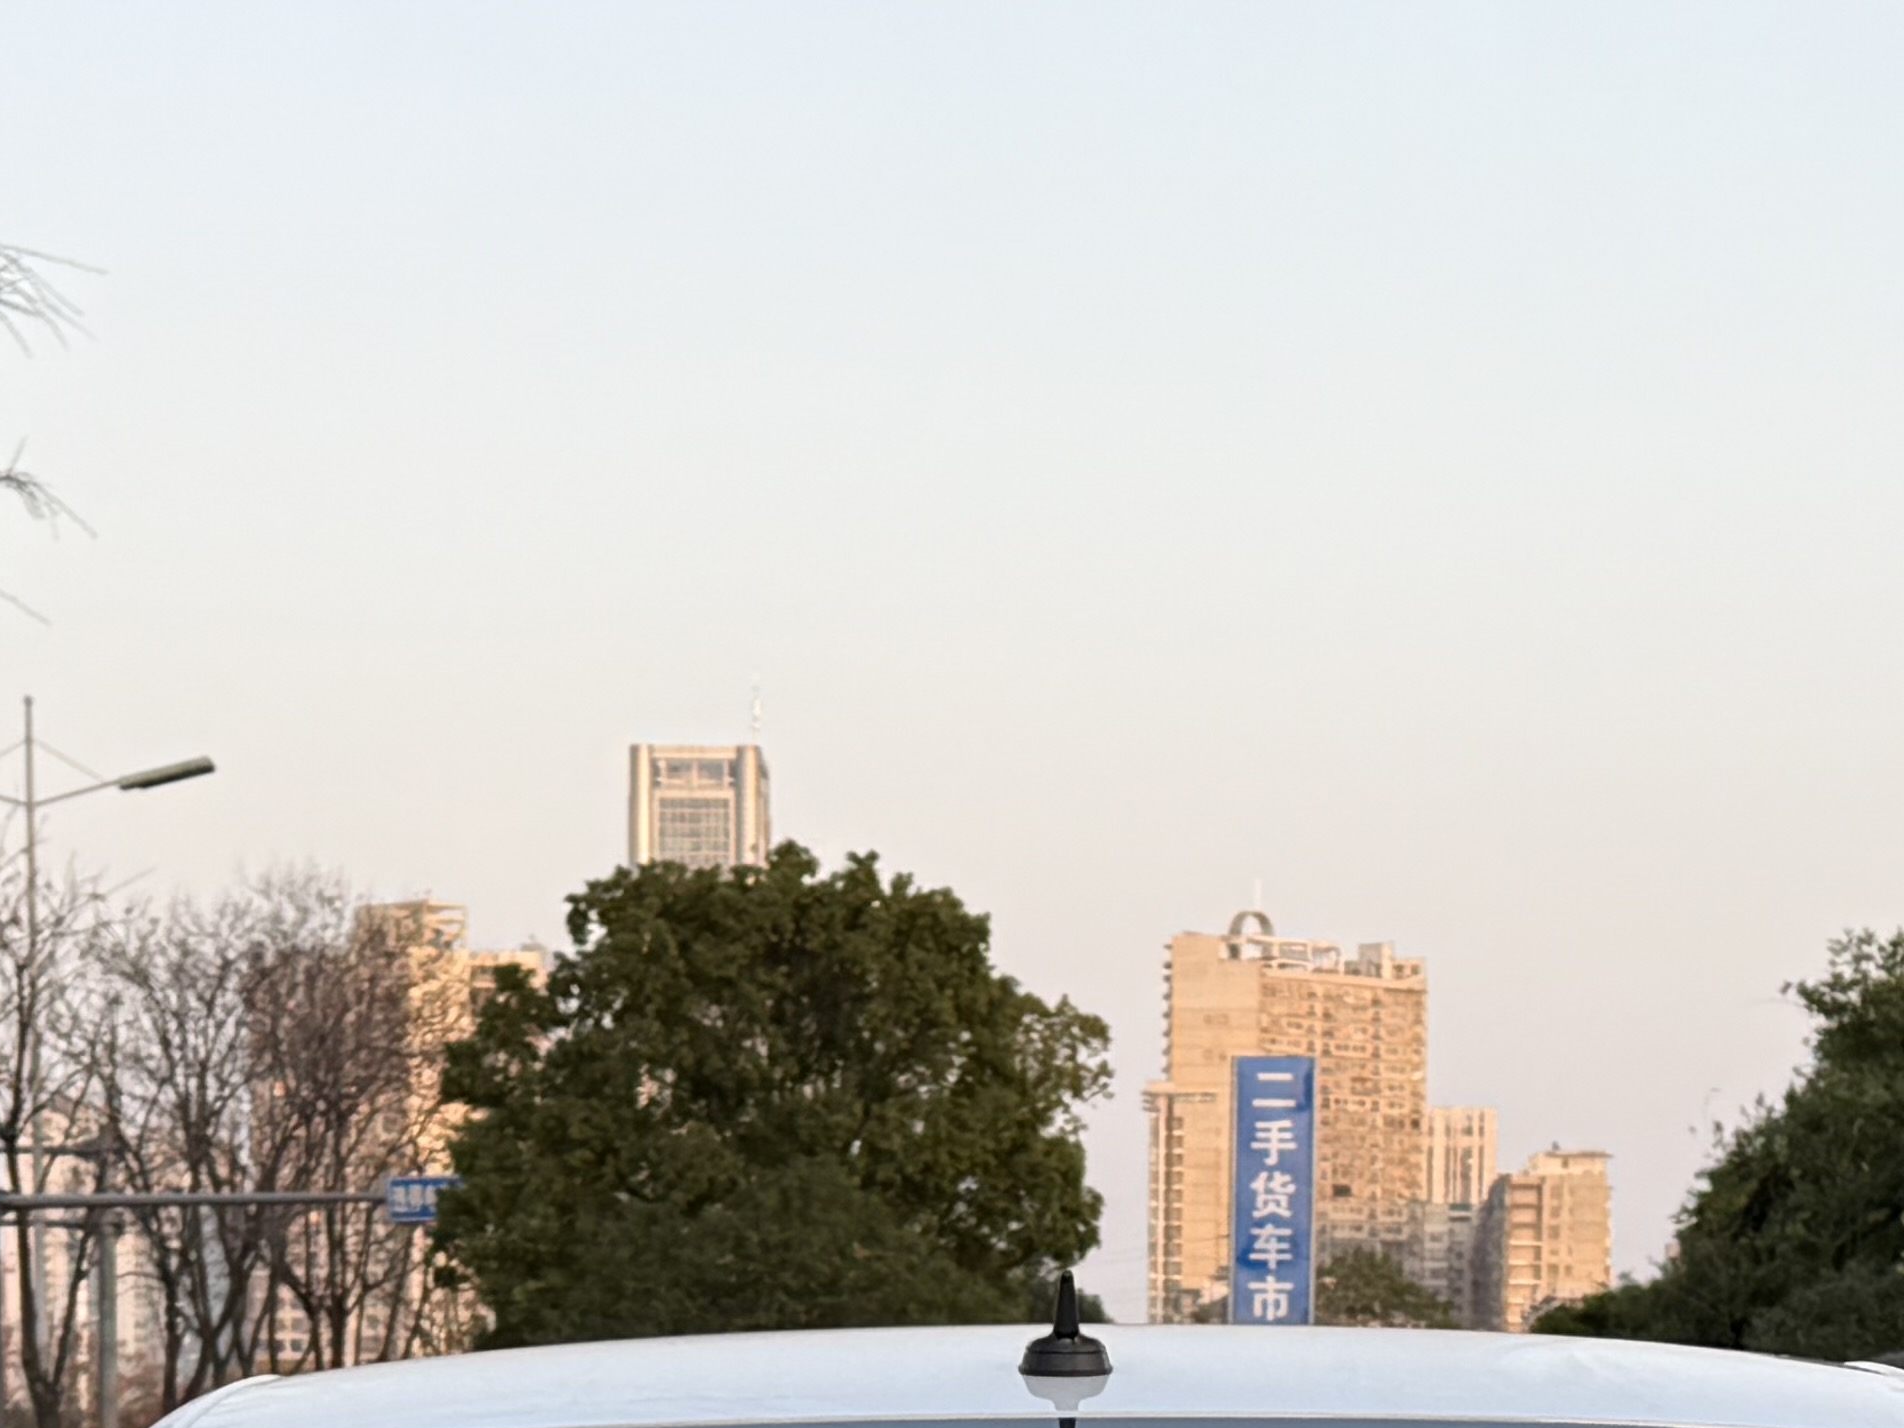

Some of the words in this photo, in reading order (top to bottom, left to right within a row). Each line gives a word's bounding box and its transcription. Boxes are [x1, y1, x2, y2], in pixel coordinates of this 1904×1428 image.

[1248, 1071, 1299, 1322] 二手货车市
